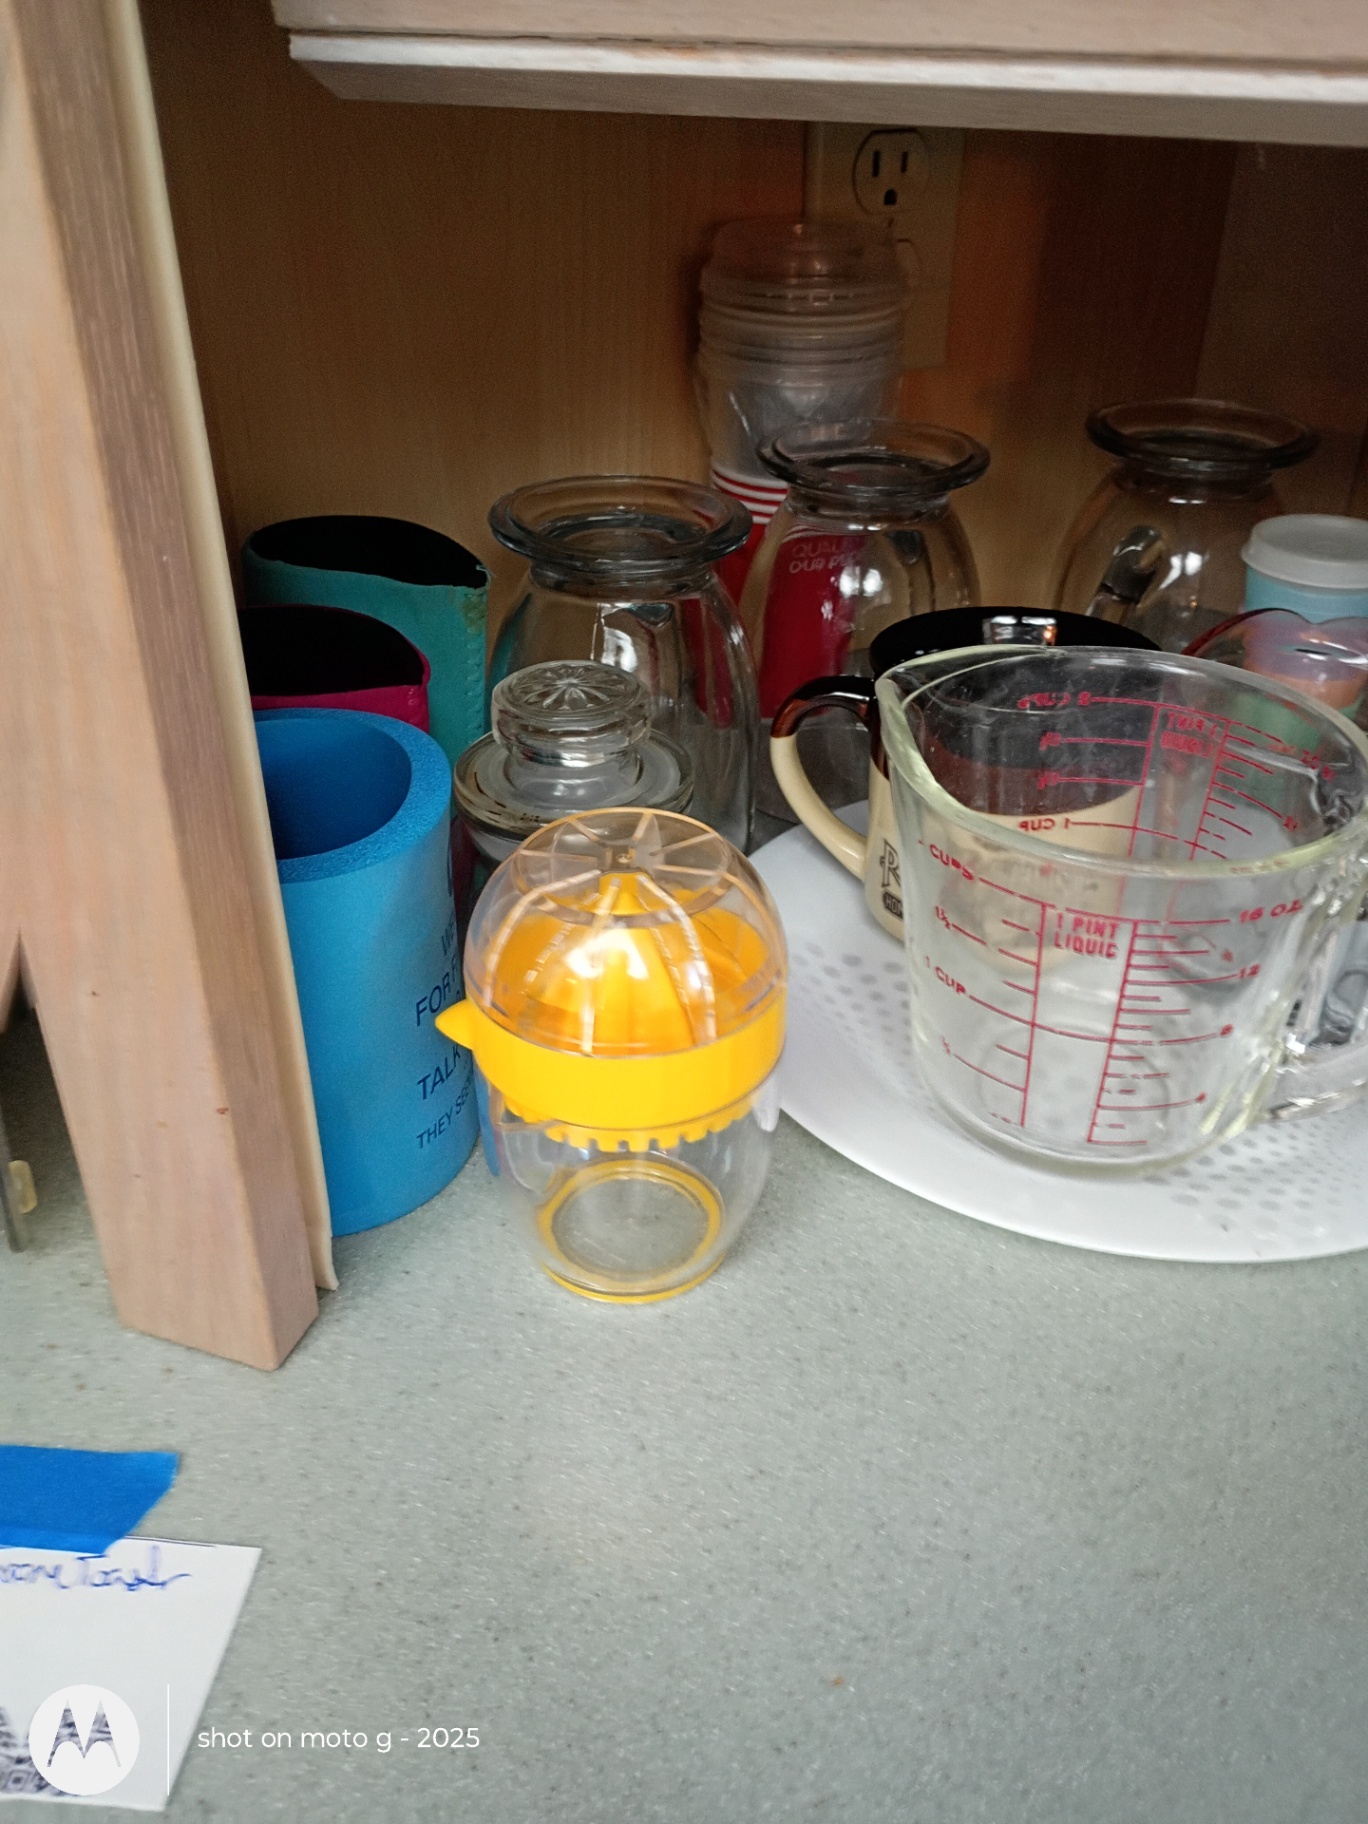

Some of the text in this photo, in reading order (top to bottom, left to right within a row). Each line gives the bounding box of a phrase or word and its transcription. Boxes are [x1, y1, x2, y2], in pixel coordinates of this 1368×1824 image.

[1072, 915, 1119, 940] PINT
[935, 966, 967, 994] CUP
[417, 1044, 461, 1100] TALK
[416, 1106, 454, 1149] THEY
